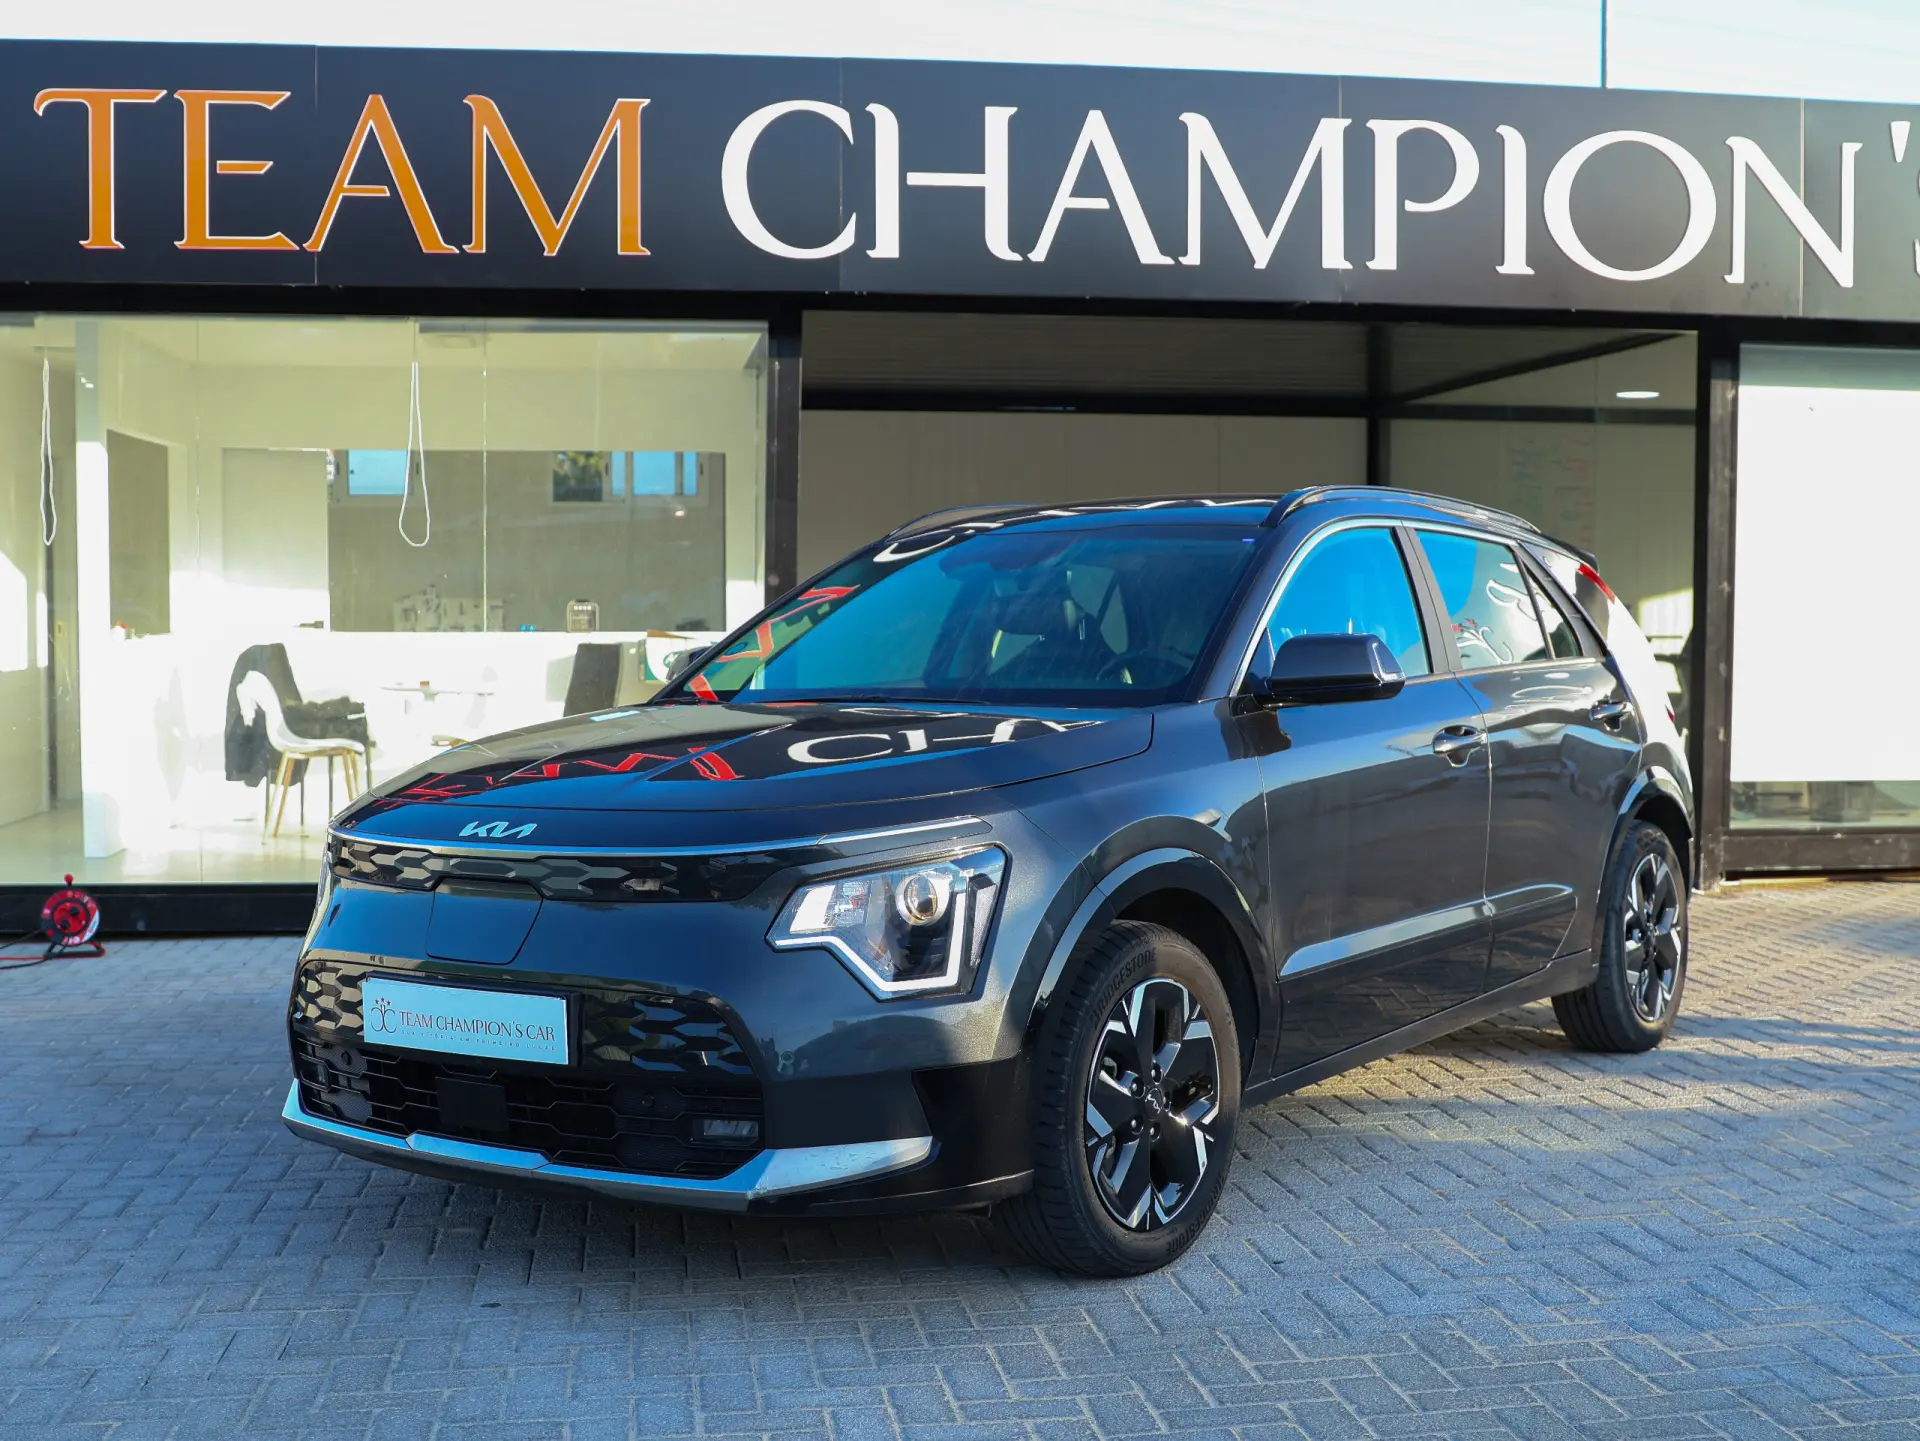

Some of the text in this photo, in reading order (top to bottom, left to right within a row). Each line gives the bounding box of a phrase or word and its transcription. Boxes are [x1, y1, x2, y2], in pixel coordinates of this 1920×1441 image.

[33, 87, 1920, 289] TEAM CHAMPION'
[458, 820, 538, 839] KIA
[399, 1010, 555, 1042] TEAM CHAMPION'S CAR
